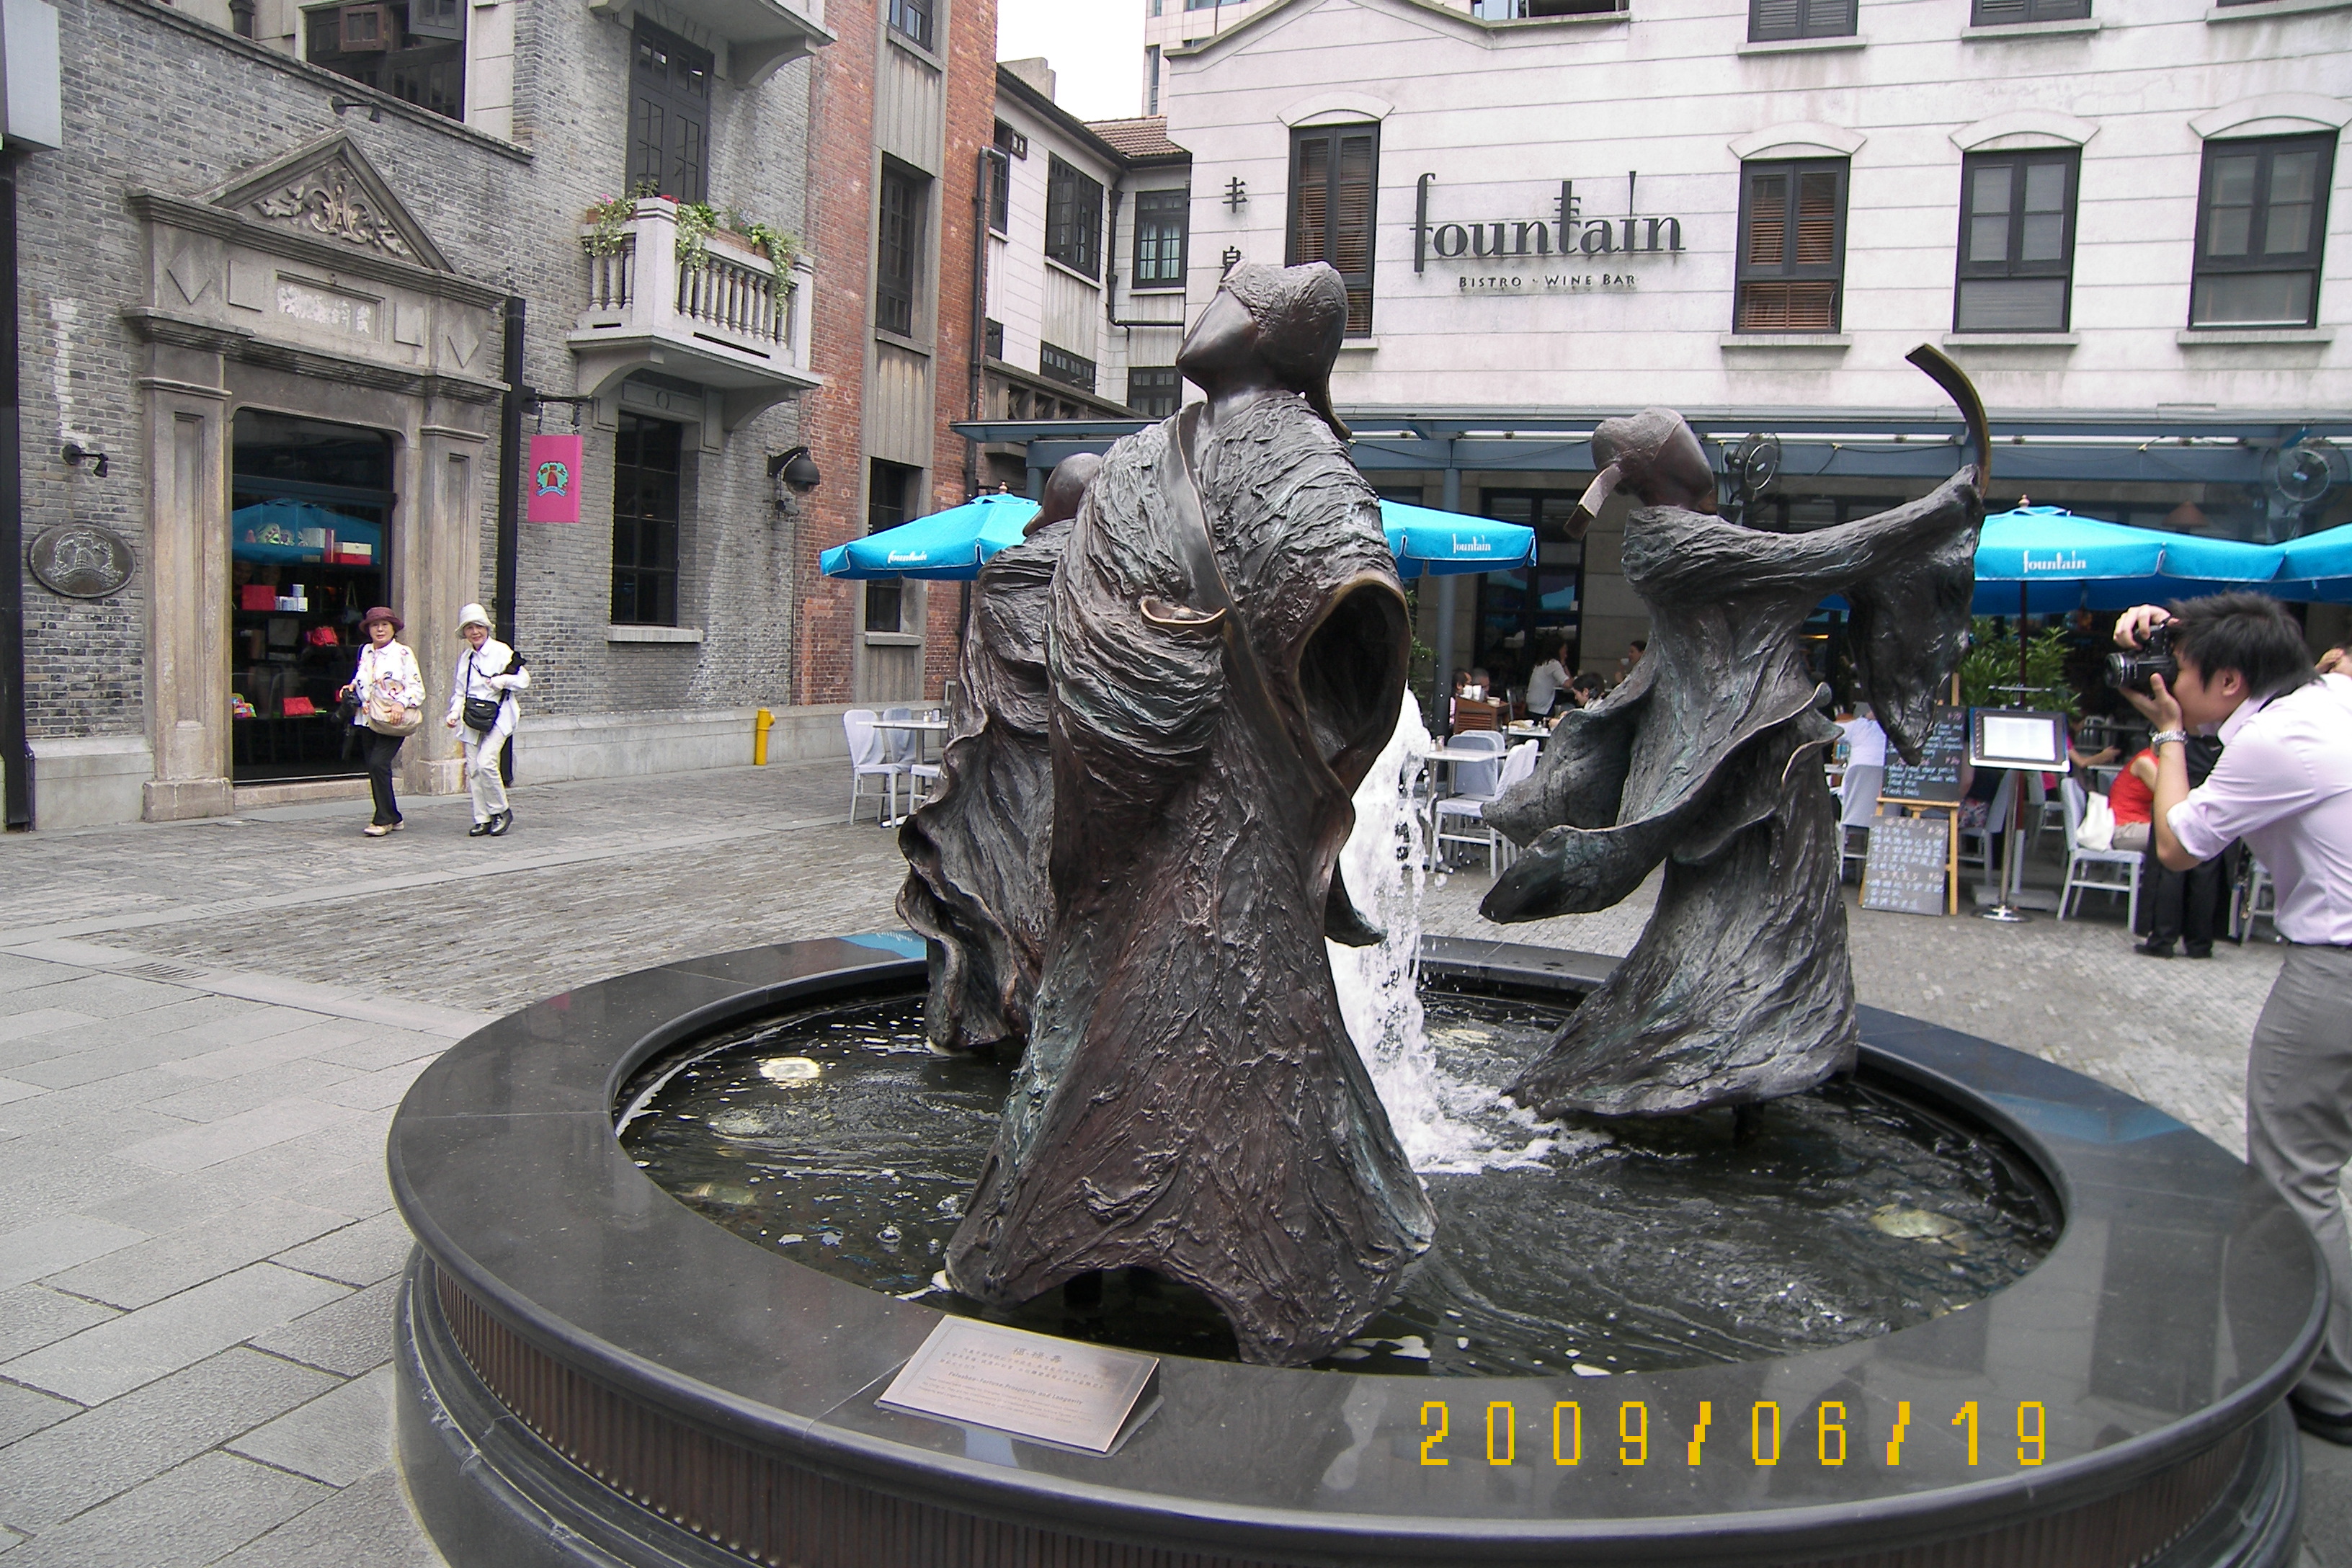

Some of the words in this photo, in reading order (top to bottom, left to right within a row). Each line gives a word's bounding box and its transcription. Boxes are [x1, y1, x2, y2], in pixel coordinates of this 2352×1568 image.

[1409, 171, 1686, 272] fountain
[1459, 277, 1522, 288] BISTRO
[1544, 275, 1592, 287] WINE
[1603, 274, 1636, 285] BAR
[1452, 533, 1491, 554] fountain
[2023, 550, 2086, 574] fountain
